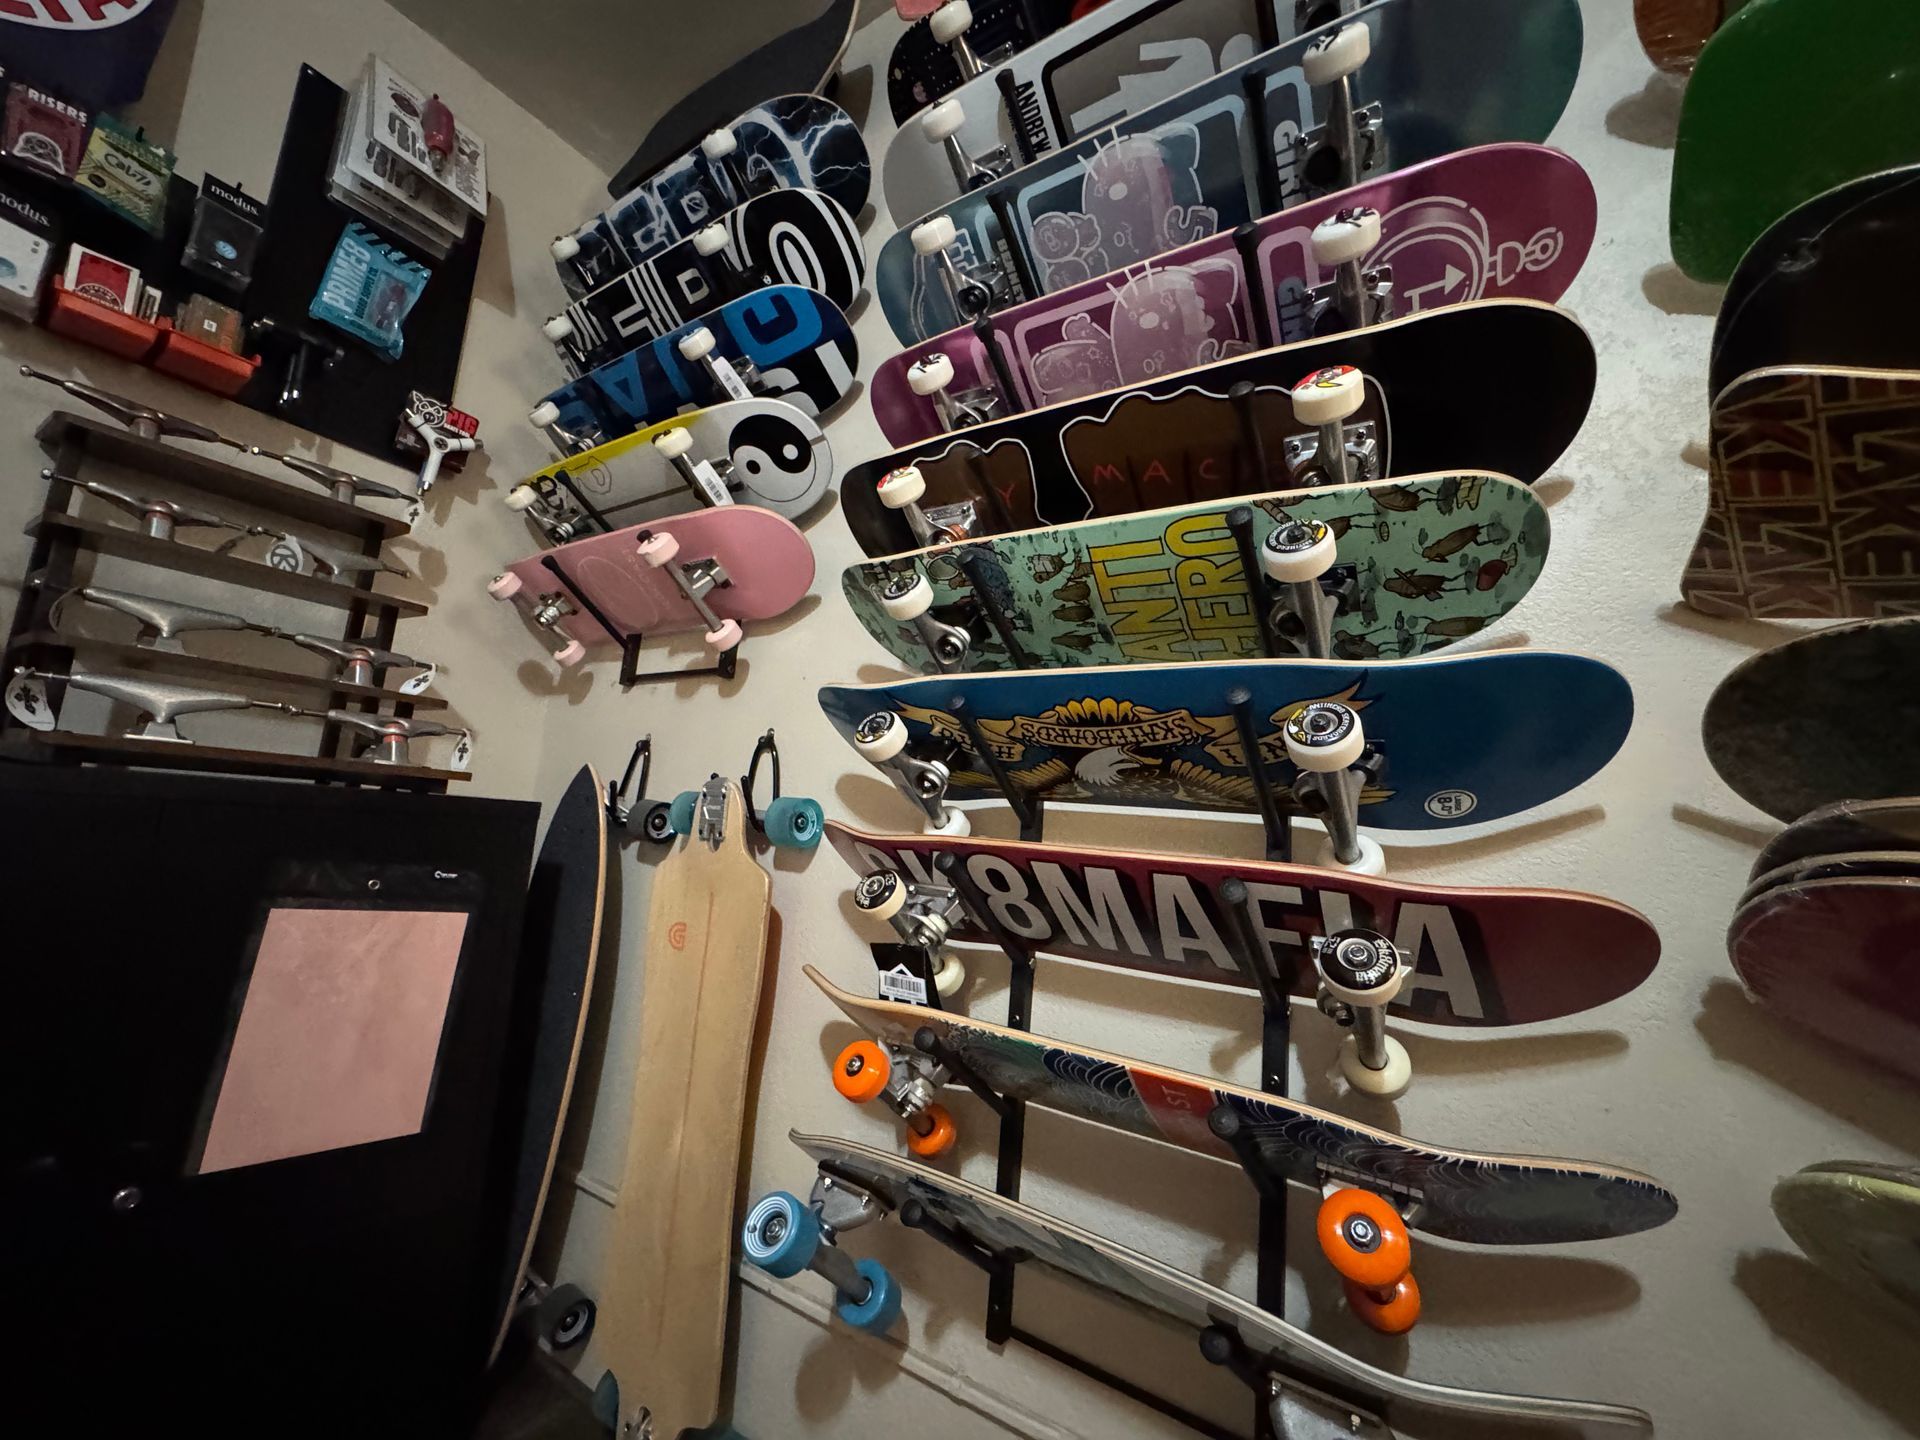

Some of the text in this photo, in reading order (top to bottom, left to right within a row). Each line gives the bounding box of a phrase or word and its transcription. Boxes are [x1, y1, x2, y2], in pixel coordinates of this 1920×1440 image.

[28, 88, 88, 124] RISERS
[1014, 80, 1052, 154] ANDREW
[211, 184, 259, 217] modus
[446, 410, 477, 436] PIG
[1086, 535, 1192, 664] ANTI
[1021, 717, 1193, 746] SKATEBOARDS
